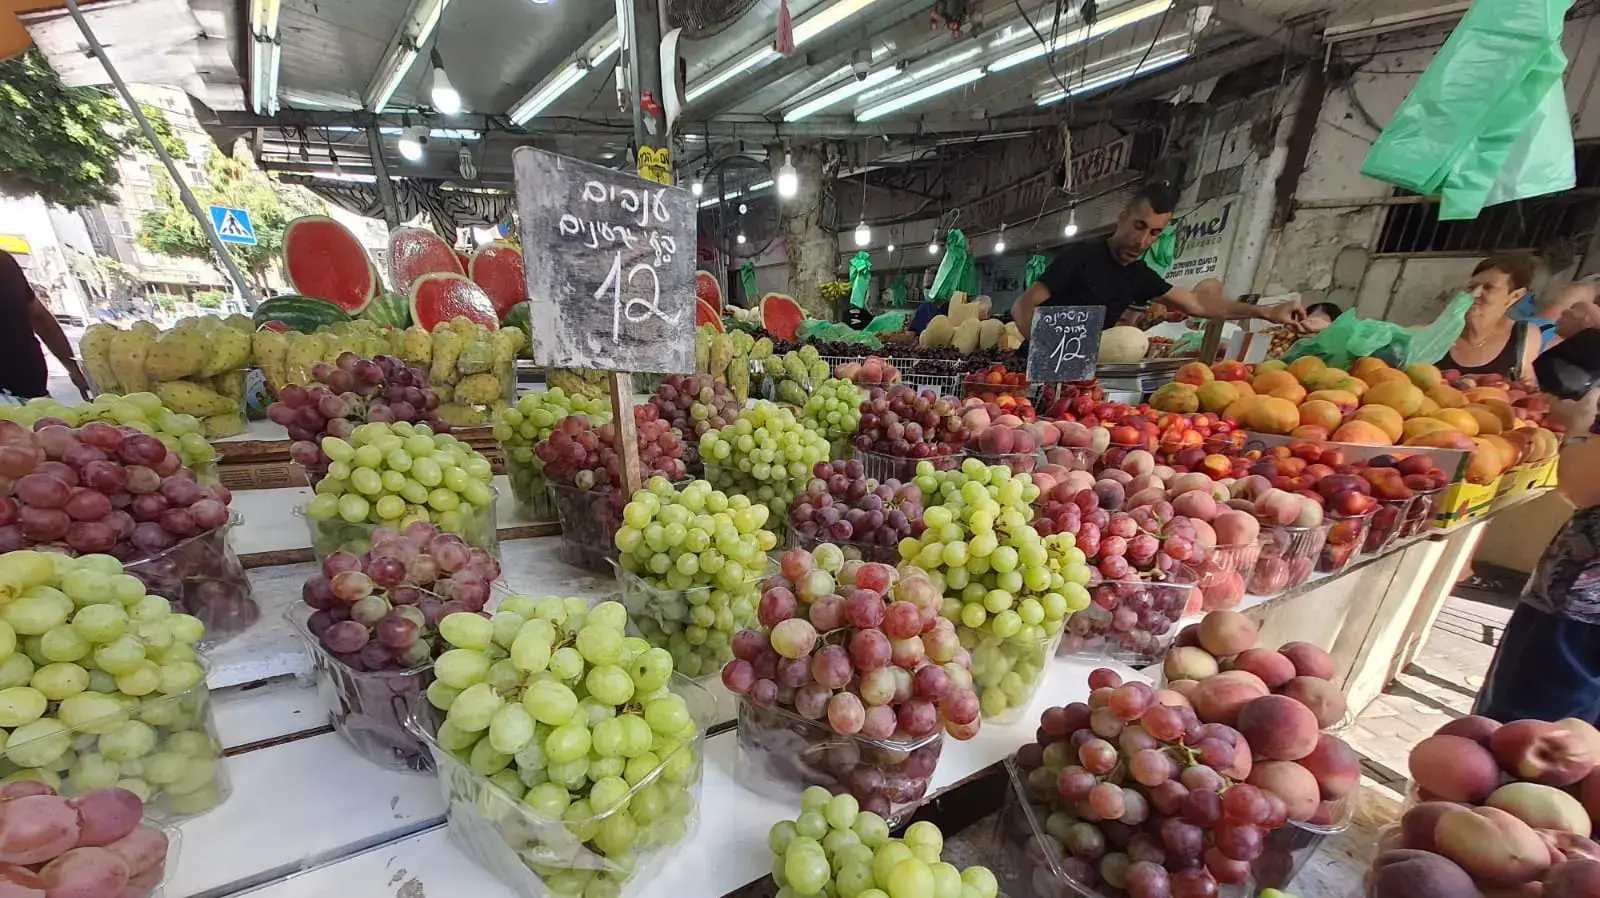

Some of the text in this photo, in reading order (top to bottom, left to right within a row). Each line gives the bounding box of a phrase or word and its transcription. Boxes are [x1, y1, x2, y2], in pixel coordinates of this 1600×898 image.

[583, 180, 670, 227] ענבים
[593, 250, 681, 344] 12
[1049, 332, 1086, 373] 12
